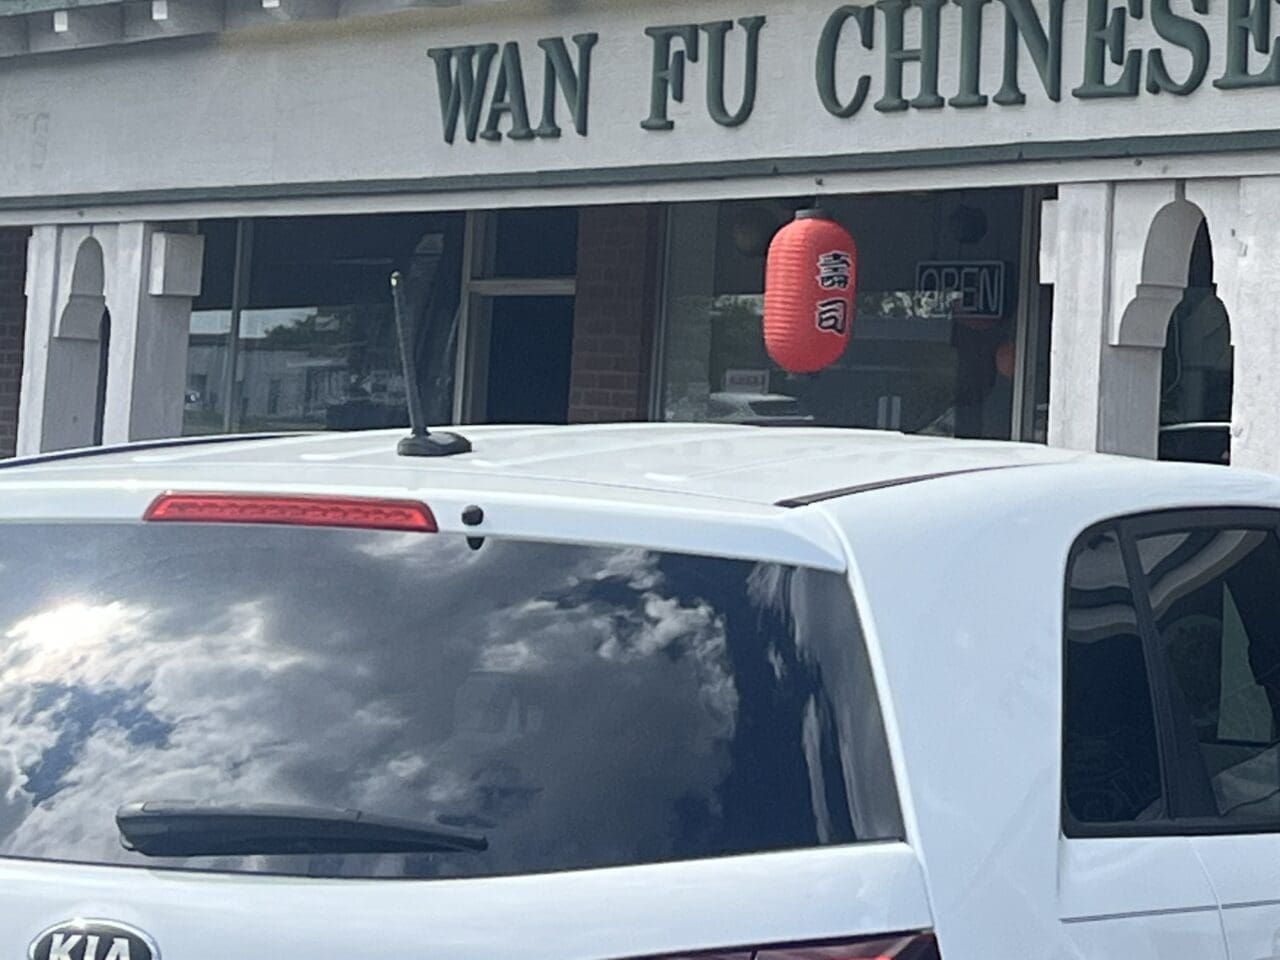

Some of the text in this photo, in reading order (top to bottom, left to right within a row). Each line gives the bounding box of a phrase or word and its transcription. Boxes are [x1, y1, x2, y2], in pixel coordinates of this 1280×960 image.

[427, 32, 599, 144] WAN
[641, 15, 766, 130] FU
[920, 266, 1000, 312] OPEN
[49, 933, 131, 960] KIA
